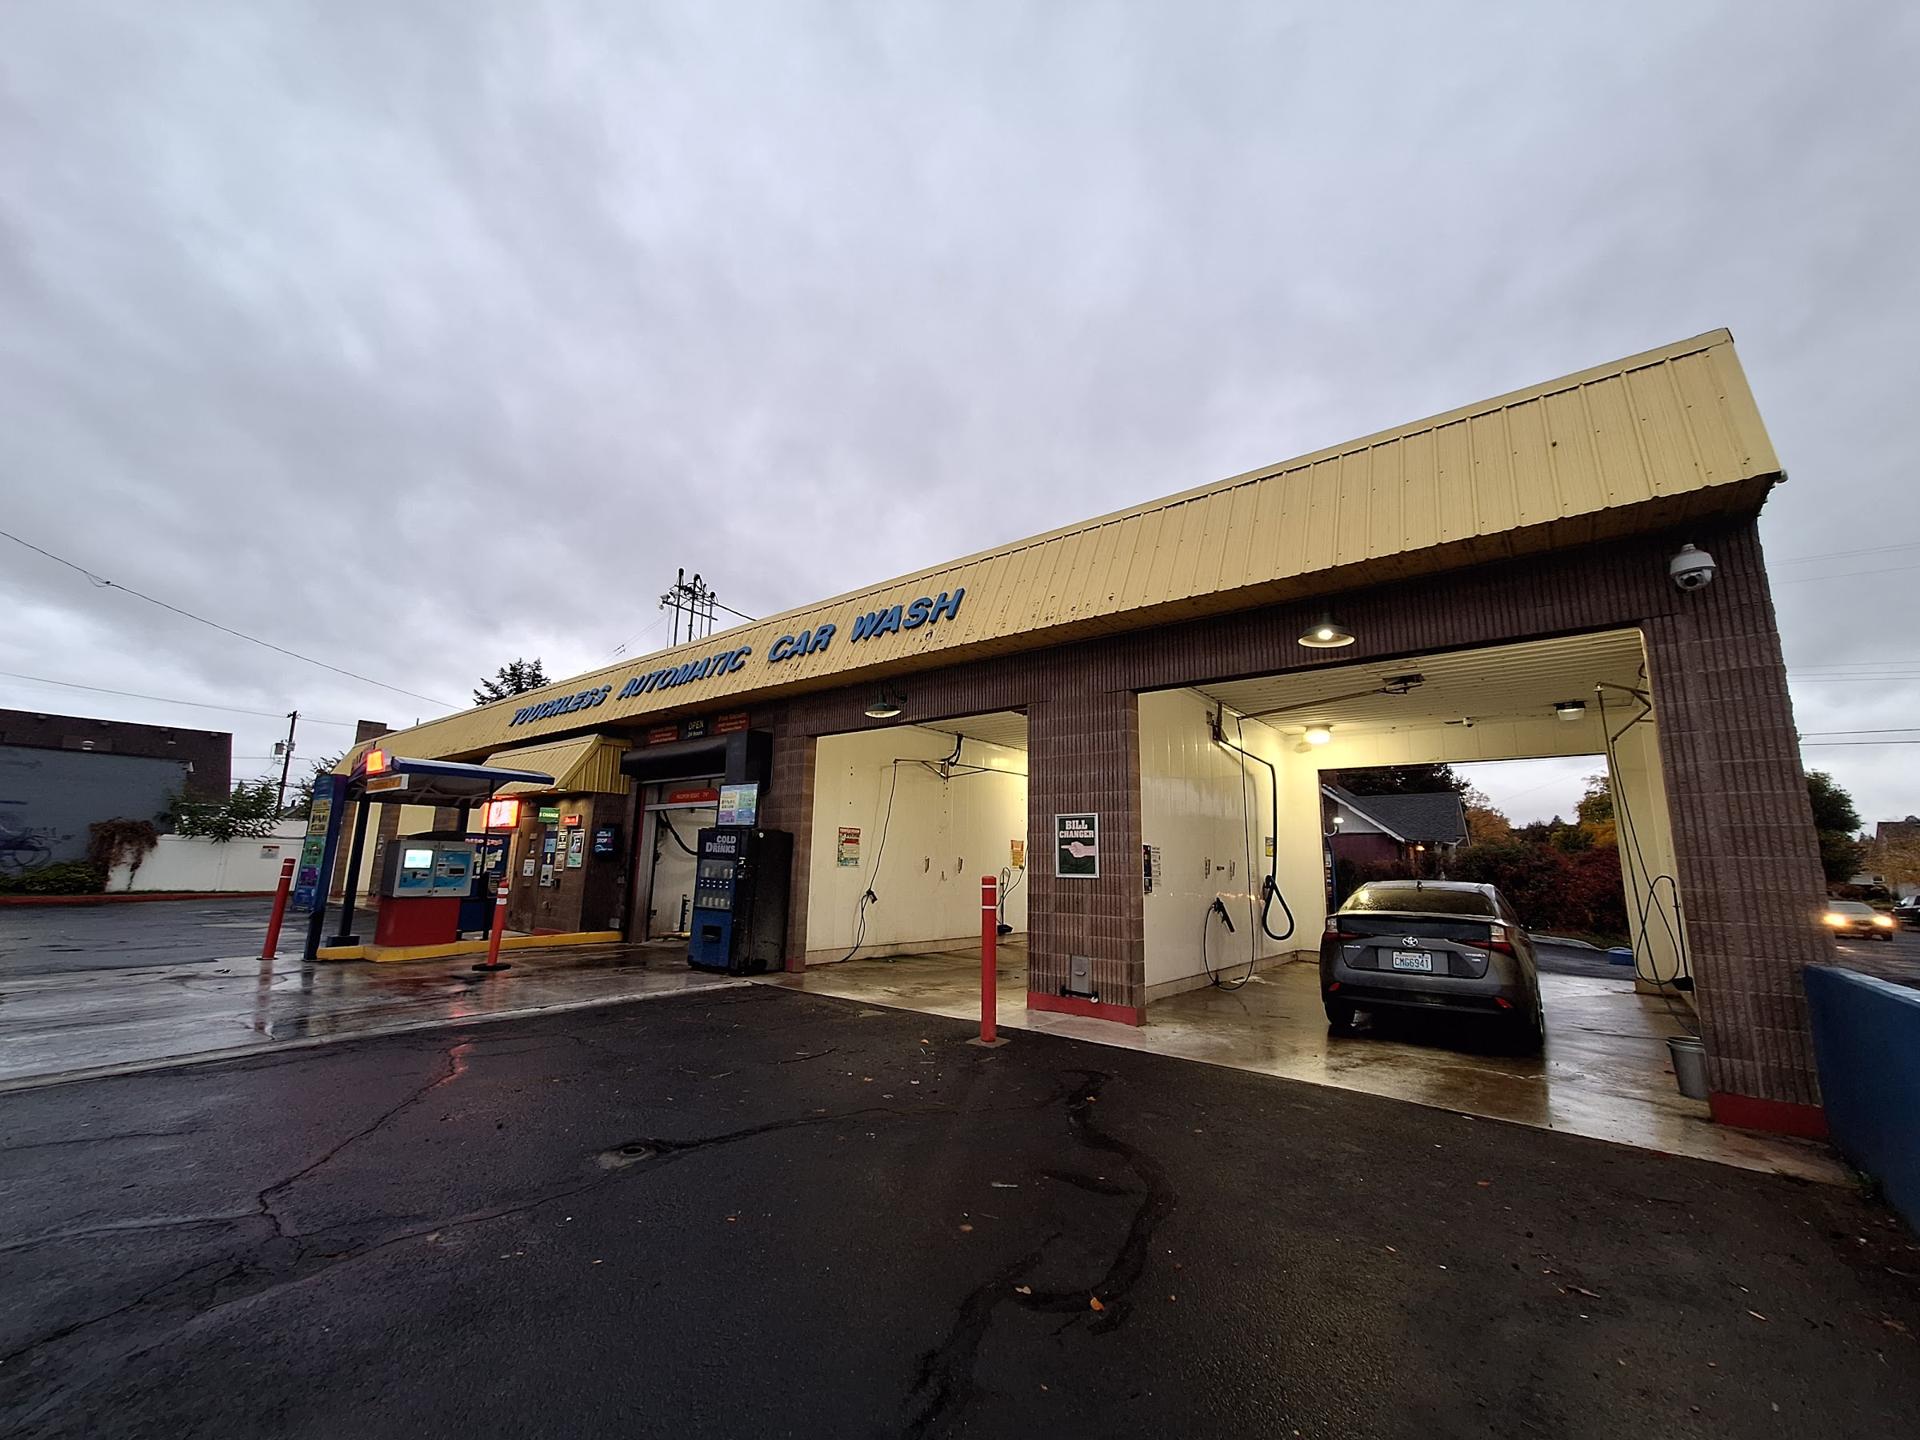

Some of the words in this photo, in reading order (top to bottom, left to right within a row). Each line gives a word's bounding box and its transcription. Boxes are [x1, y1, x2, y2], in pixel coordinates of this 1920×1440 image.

[508, 684, 612, 727] TOUCHLESS
[616, 646, 752, 701] AUTOMATIC
[767, 623, 836, 663] CAR
[850, 587, 966, 643] WASH
[688, 720, 704, 730] OPEN
[1065, 820, 1088, 830] BILL
[716, 835, 737, 844] COLD
[1059, 830, 1095, 839] CHANGER
[705, 842, 736, 854] DRINKS
